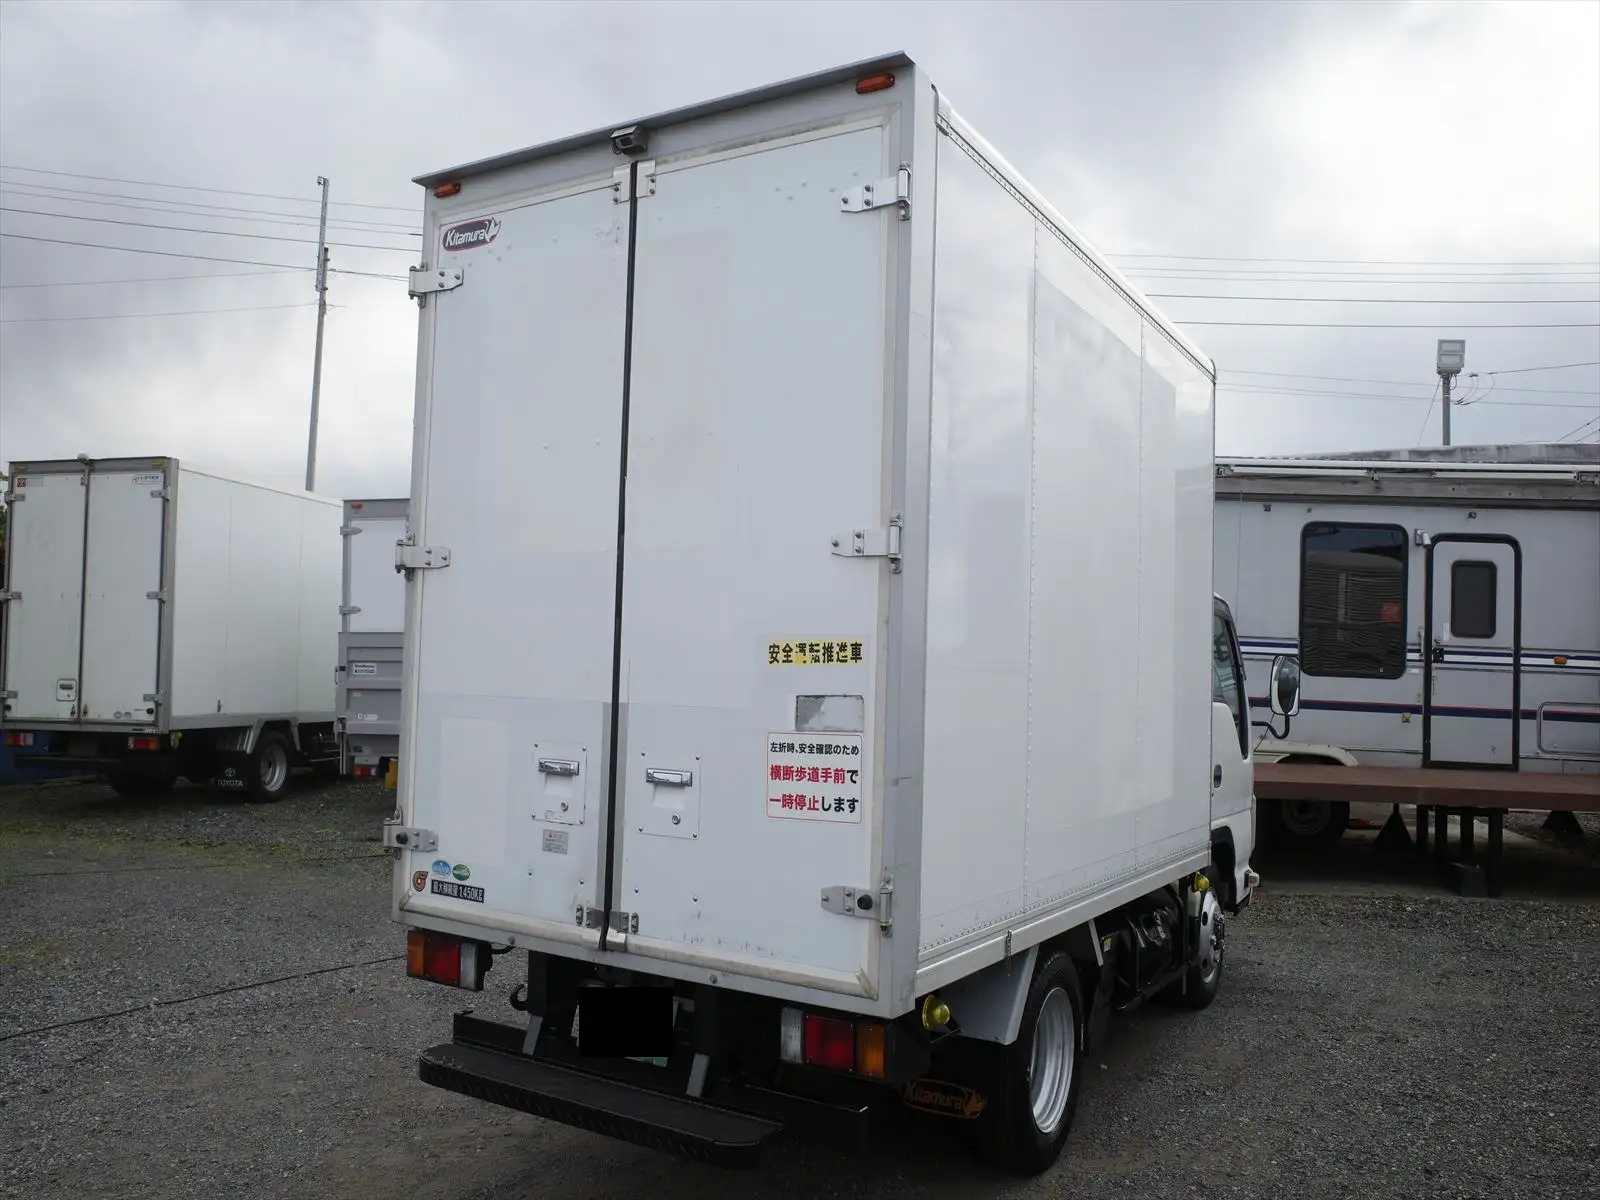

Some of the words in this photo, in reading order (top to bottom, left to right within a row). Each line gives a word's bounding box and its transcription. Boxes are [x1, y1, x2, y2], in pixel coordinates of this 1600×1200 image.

[445, 229, 486, 248] Kitamura
[770, 741, 860, 756] 左折時、安全確認のため
[217, 779, 244, 788] TOYOTA
[770, 764, 859, 784] 横断歩道手前で
[769, 793, 859, 814] 一時停止します
[903, 1080, 963, 1110] Kitamura
